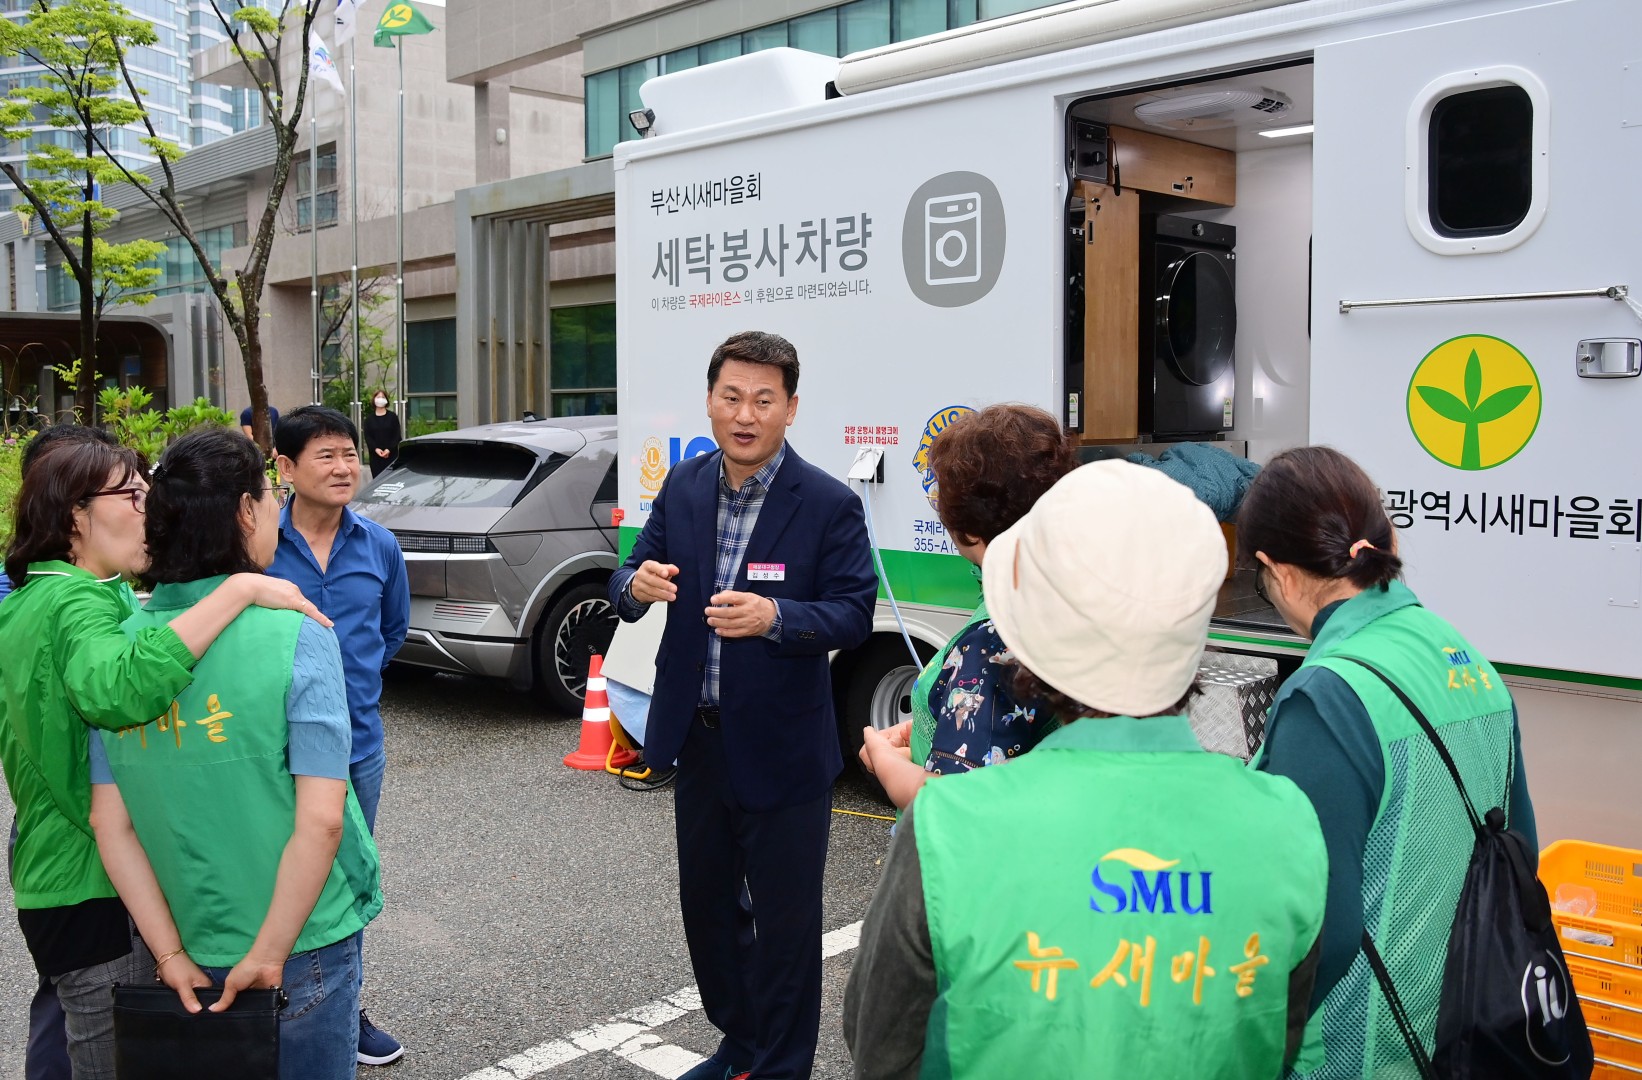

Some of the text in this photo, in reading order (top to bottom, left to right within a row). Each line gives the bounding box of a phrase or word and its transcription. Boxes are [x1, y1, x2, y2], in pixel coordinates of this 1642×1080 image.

[650, 172, 761, 216] 부산시새마을회
[651, 212, 872, 287] 세탁봉사차량
[651, 278, 872, 311] 이 차량은 국제라이온스 의 후원으로 마련되었습니다.
[844, 426, 856, 435] 차량
[1380, 488, 1642, 543] 광역시새마을회
[914, 537, 949, 553] 355-A
[1089, 864, 1214, 915] SMU
